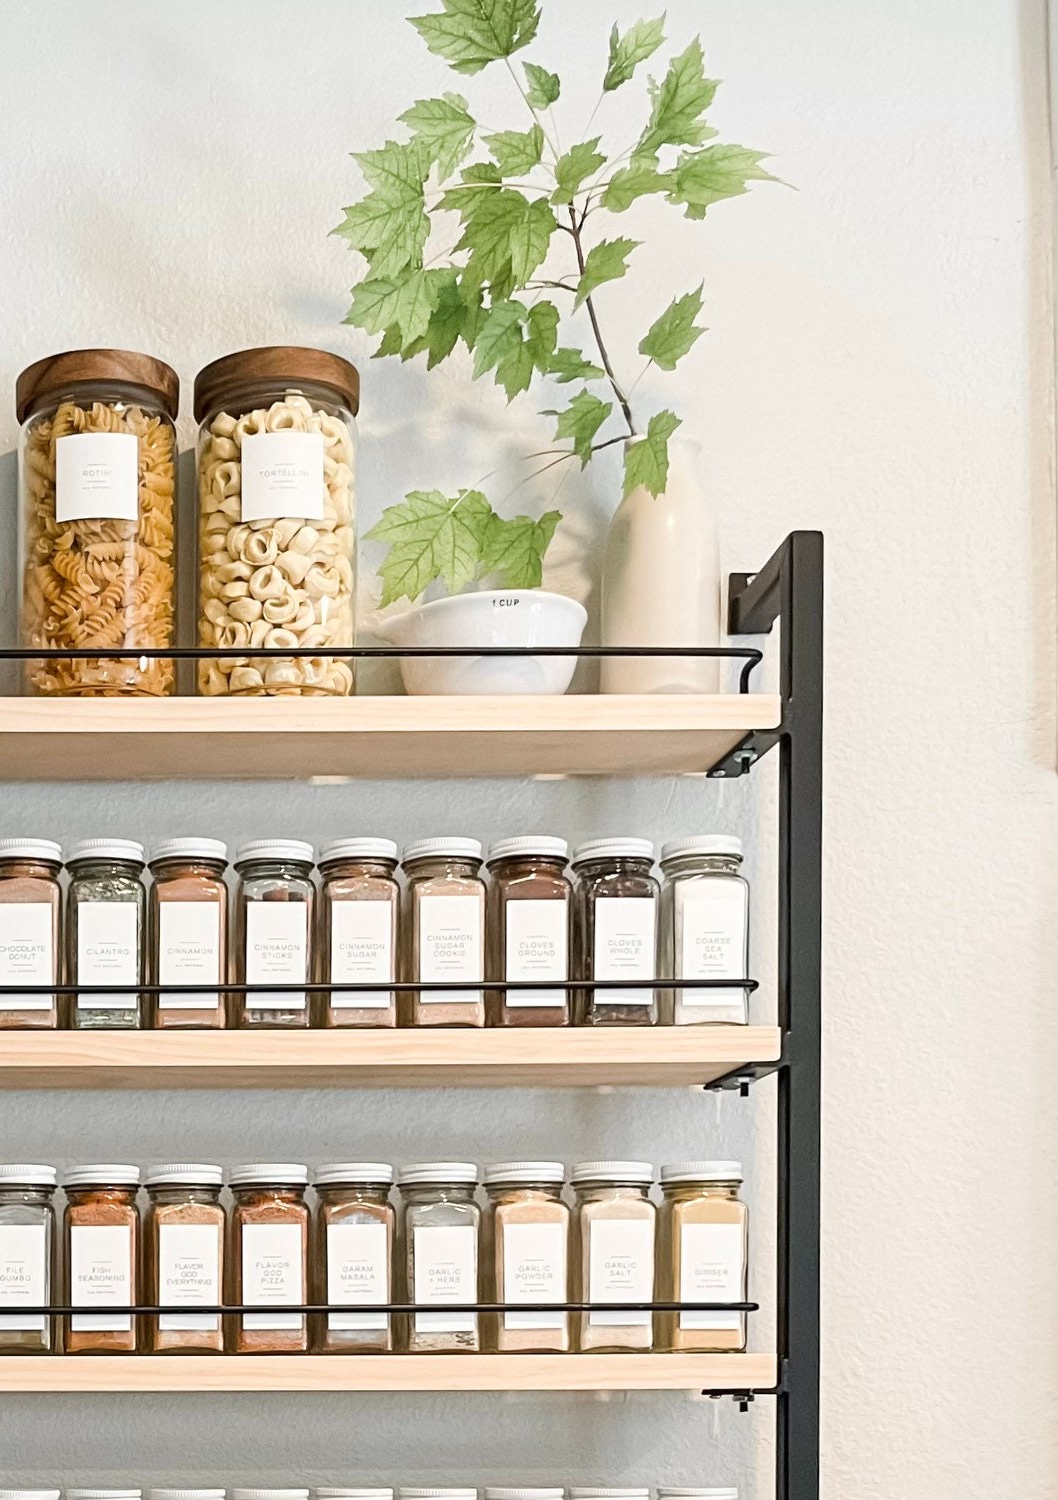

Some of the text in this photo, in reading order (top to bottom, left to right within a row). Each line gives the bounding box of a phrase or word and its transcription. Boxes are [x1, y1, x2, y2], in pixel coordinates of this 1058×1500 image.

[499, 599, 520, 607] CUP
[426, 934, 473, 942] CINNAMON
[695, 937, 732, 945] COARSE
[339, 943, 385, 951] CINNAMON
[434, 942, 465, 950] SUGAR
[519, 941, 554, 949] CLOVES
[607, 939, 642, 947] CLOVES
[0, 945, 46, 953] CHOCOLATE
[167, 947, 213, 955] CINNAMON
[254, 943, 301, 952] CINNAMON
[86, 948, 129, 956] CILANTRO
[261, 951, 293, 960] STICKS
[347, 950, 378, 959] SUGAR
[433, 950, 466, 958] COOKIE
[174, 1262, 204, 1271] FLAVOR
[255, 1261, 289, 1269] FLAVOR
[342, 1265, 374, 1273] GARAM
[518, 1264, 550, 1273] GARLIC
[604, 1261, 637, 1270] GARLIC
[428, 1268, 460, 1276] GARLIC
[515, 1272, 553, 1280] POWDER
[609, 1269, 631, 1277] SALT
[0, 1274, 31, 1282] GUMBO
[77, 1274, 125, 1283] SEASONING
[260, 1277, 285, 1285] PIZZA
[340, 1273, 376, 1281] MASALA
[437, 1276, 461, 1284] HERB
[166, 1278, 212, 1286] EVERYTHING
